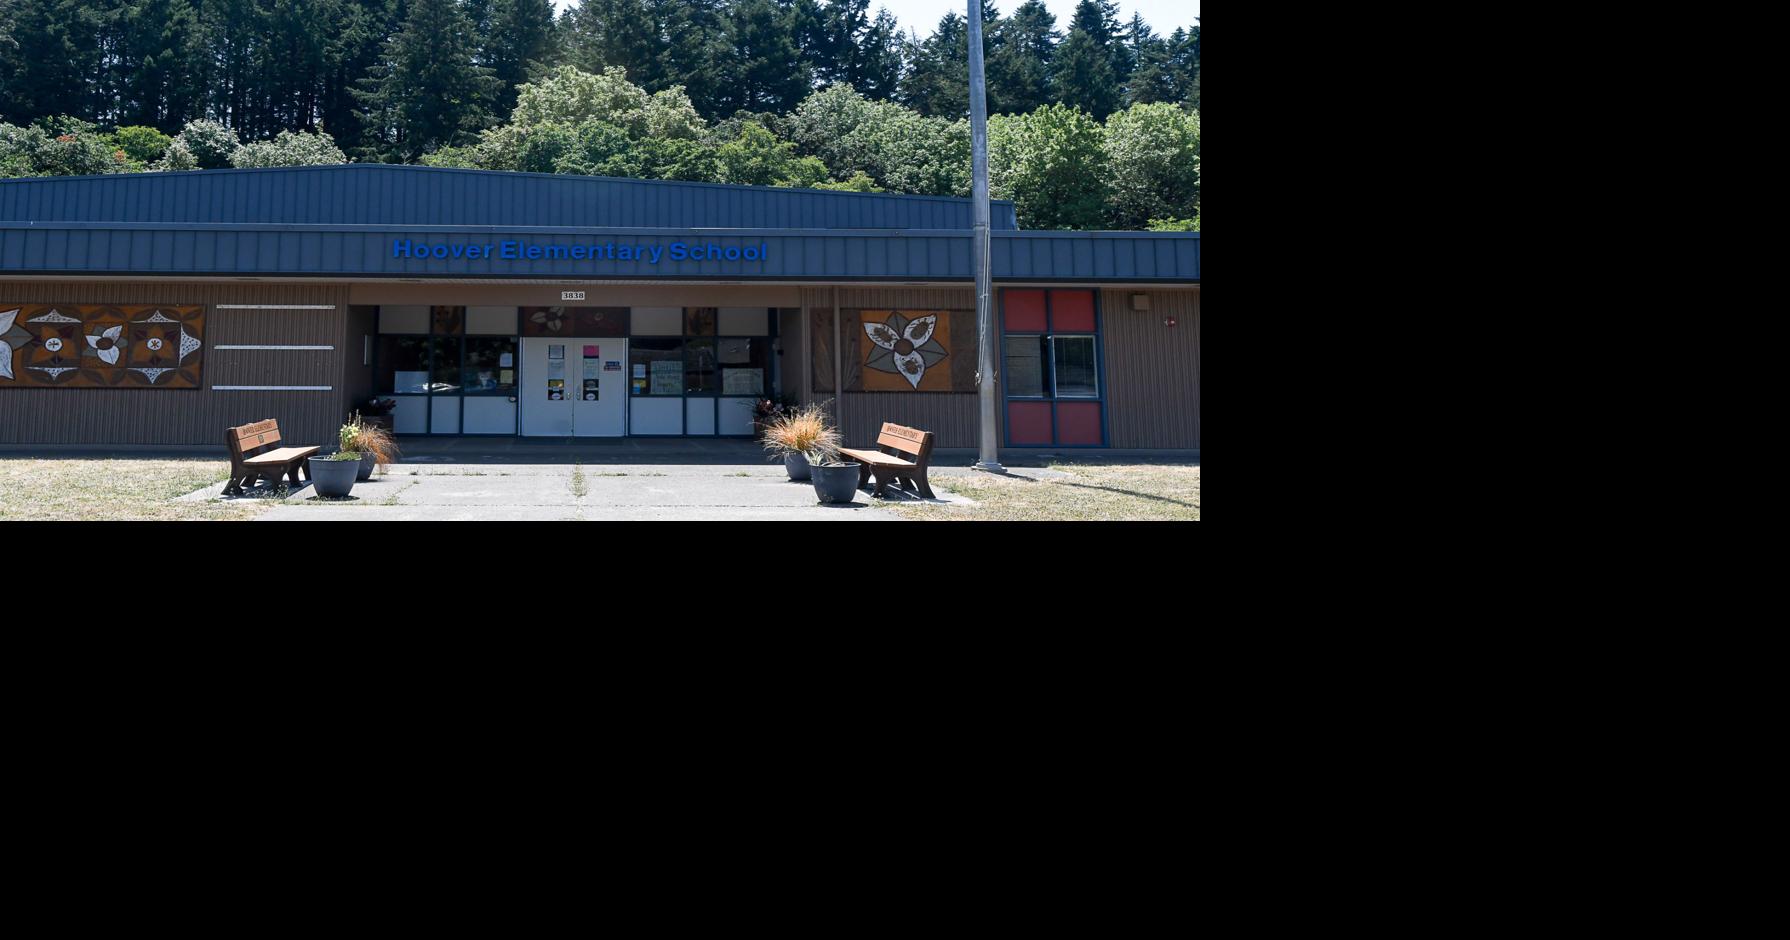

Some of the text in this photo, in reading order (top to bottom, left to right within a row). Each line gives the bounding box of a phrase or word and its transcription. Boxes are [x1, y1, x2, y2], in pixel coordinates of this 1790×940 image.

[393, 239, 767, 264] Hoover Elementary School
